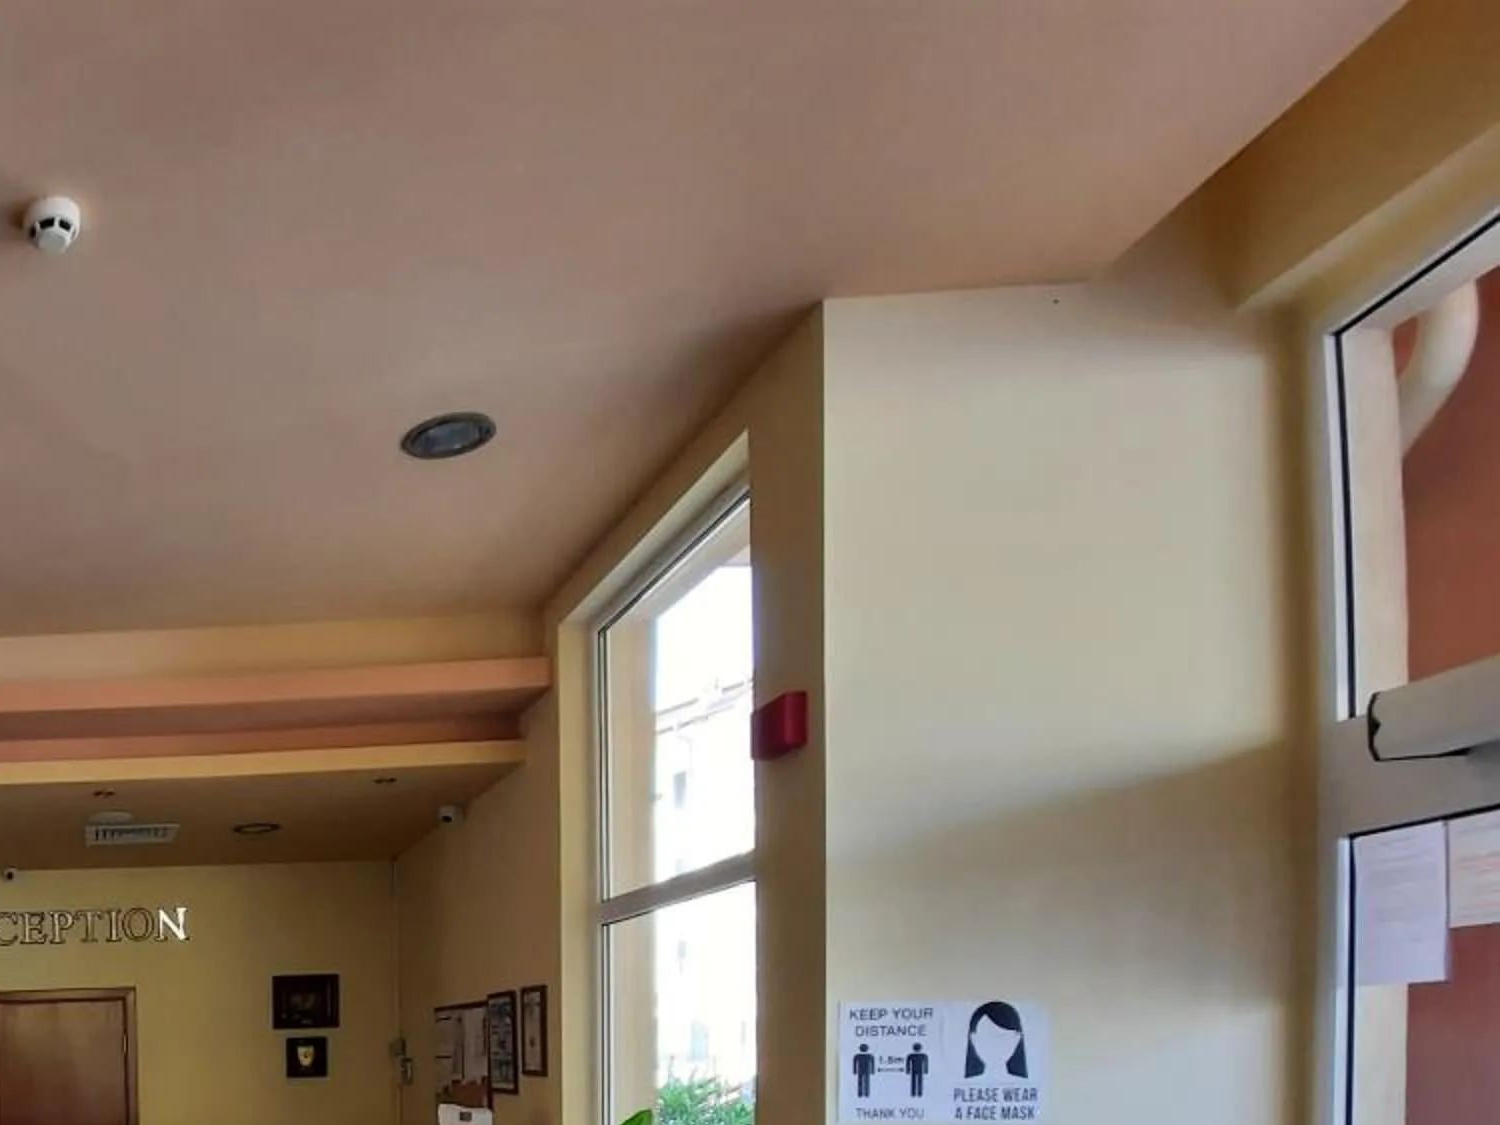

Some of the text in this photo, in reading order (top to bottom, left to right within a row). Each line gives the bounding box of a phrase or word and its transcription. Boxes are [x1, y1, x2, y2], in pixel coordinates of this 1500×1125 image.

[849, 1008, 933, 1020] KEEP YOUR
[855, 1025, 927, 1036] DISTANCE
[954, 1088, 1037, 1102] PLEASE WEAR
[856, 1107, 924, 1119] THANK YOU
[955, 1106, 1036, 1120] A FACE MASK
